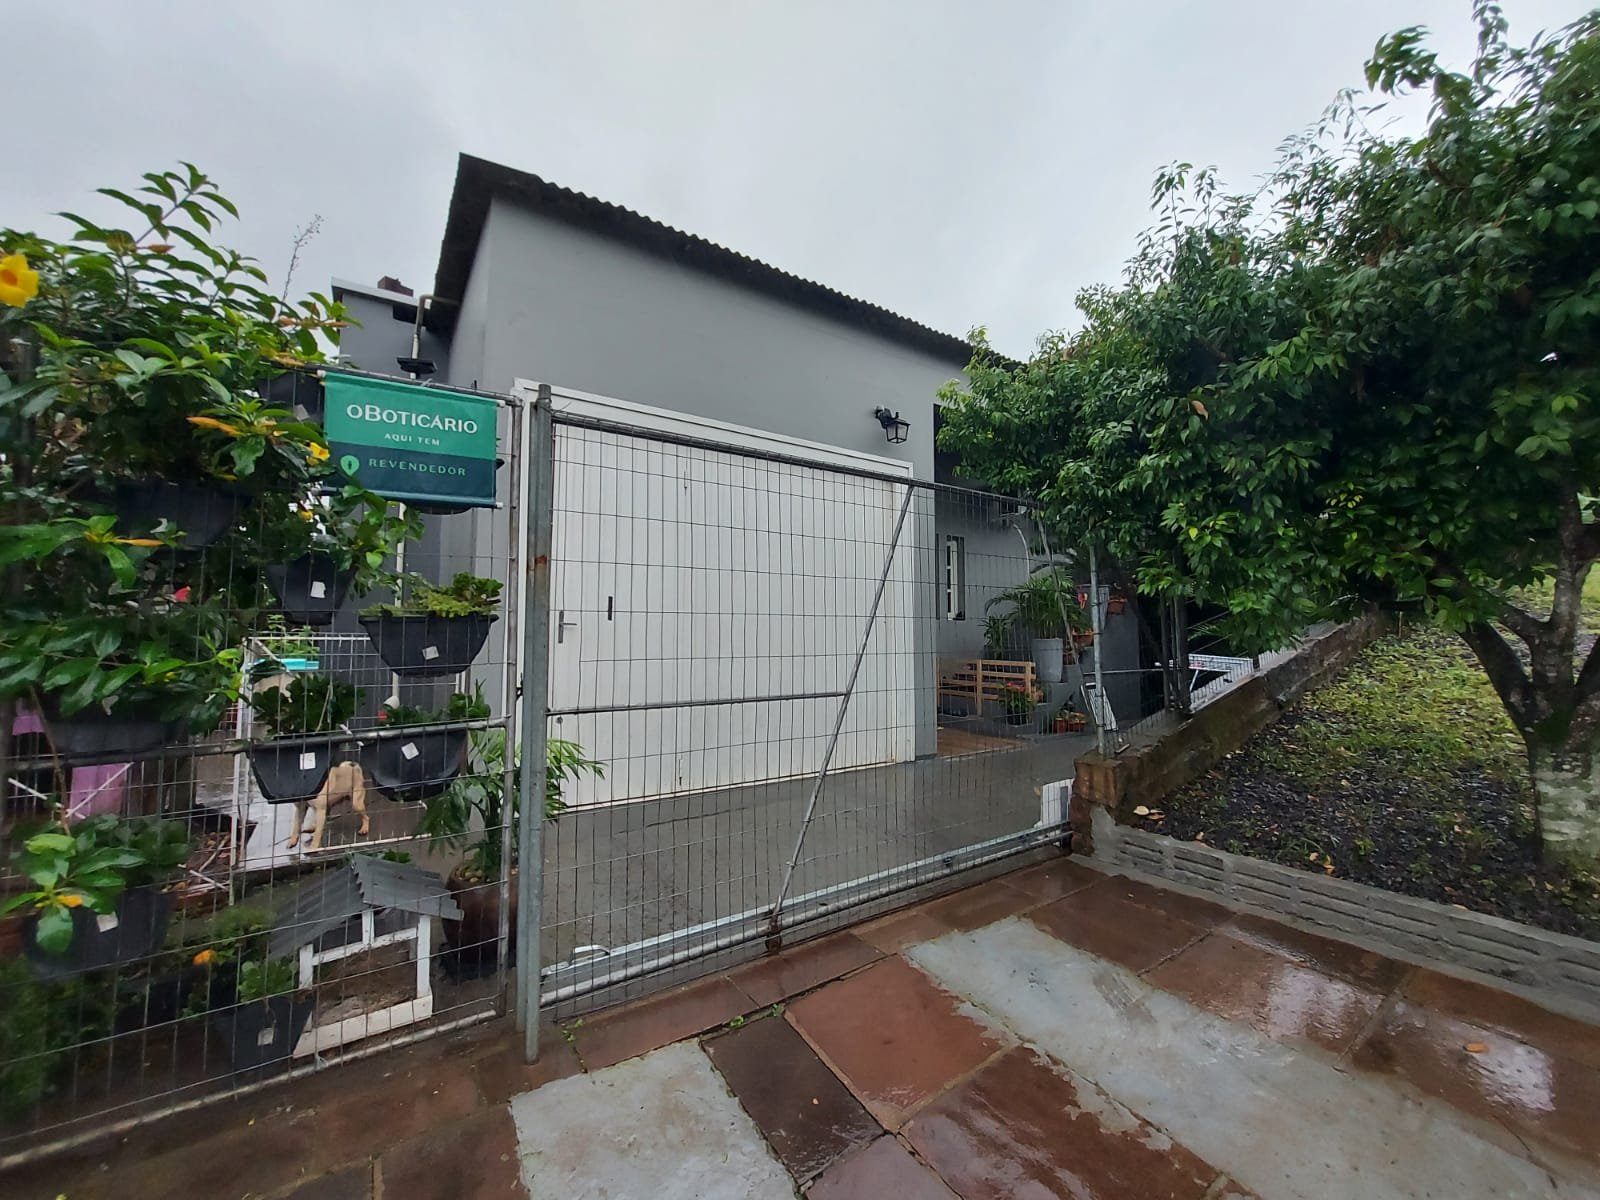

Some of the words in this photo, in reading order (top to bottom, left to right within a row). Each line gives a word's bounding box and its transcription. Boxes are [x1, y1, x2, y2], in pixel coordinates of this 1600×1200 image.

[384, 432, 412, 443] AQUI
[417, 436, 440, 447] TEM
[368, 458, 467, 476] REVENDEDOR
